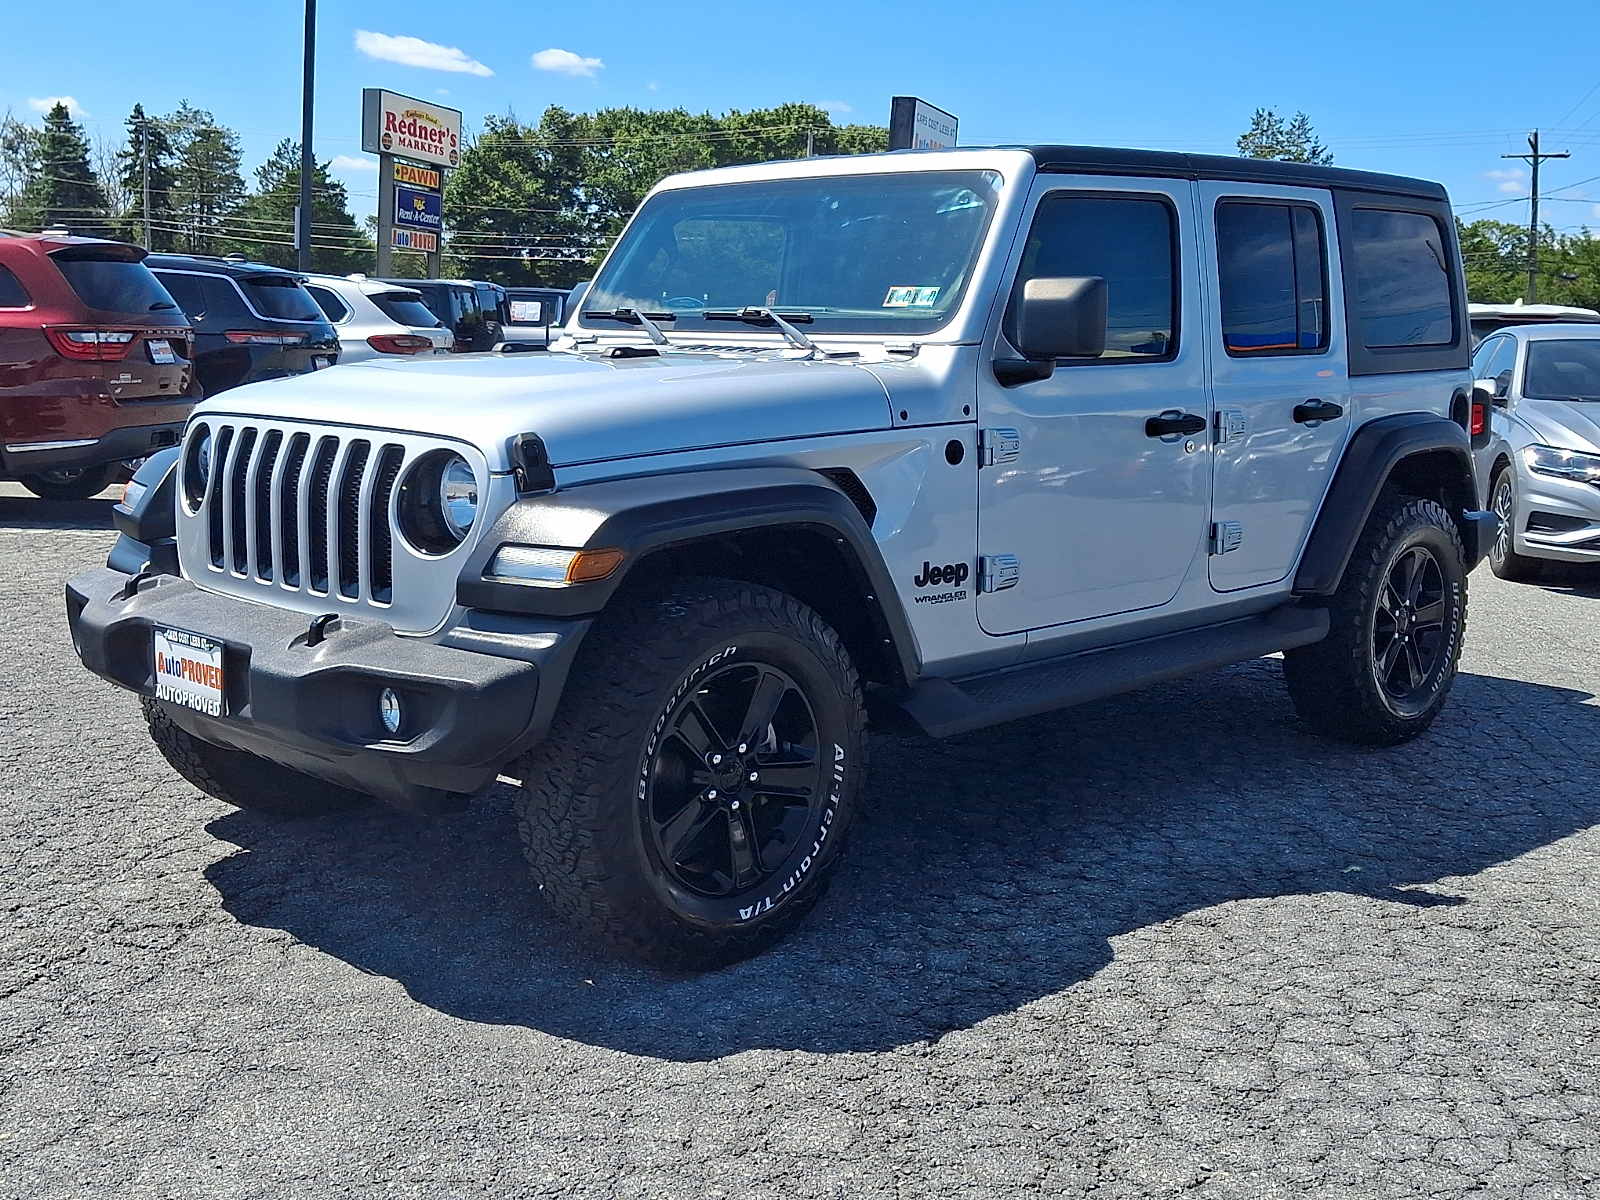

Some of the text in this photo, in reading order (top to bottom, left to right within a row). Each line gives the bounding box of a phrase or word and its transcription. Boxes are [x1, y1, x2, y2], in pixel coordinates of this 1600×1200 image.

[385, 111, 457, 148] Redner's
[917, 112, 928, 126] CARS
[928, 118, 939, 130] COST
[939, 122, 950, 136] LESS
[398, 136, 445, 156] MARKETS
[400, 165, 438, 187] PAWN
[914, 561, 969, 588] Jeep
[914, 590, 967, 604] WRANGLER
[158, 652, 223, 690] AutoPROVED
[155, 683, 221, 717] AUTOPROVED
[638, 645, 738, 801] BFGoodrich
[738, 742, 846, 921] All-Terrain T/A
